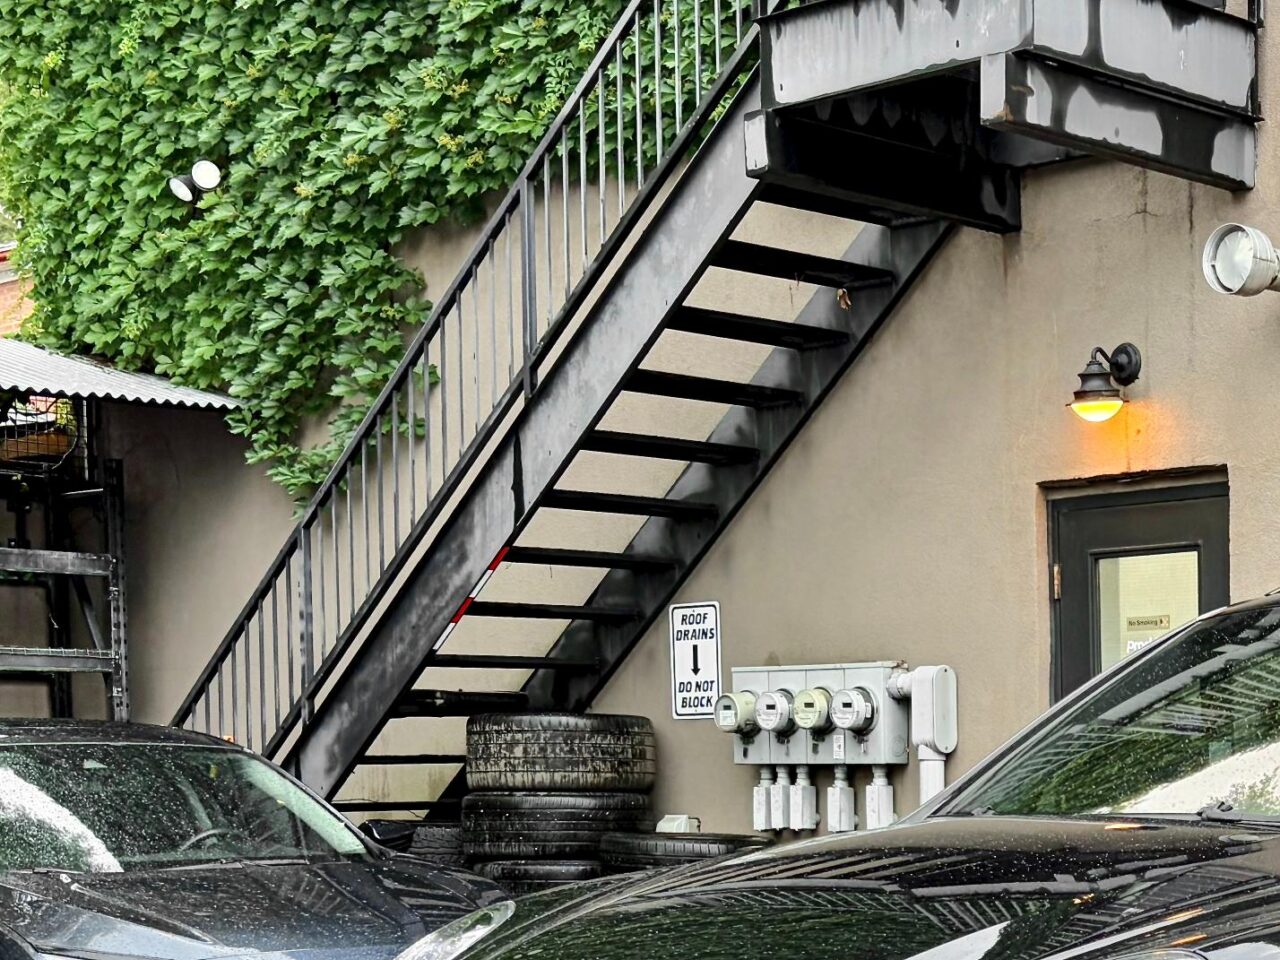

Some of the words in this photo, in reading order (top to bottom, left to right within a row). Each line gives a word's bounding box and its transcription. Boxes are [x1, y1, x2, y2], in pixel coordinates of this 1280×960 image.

[681, 613, 708, 625] ROOF
[676, 628, 715, 641] DRAINS
[678, 681, 692, 693] DO
[695, 680, 715, 692] NOT
[681, 696, 713, 708] BLOCK
